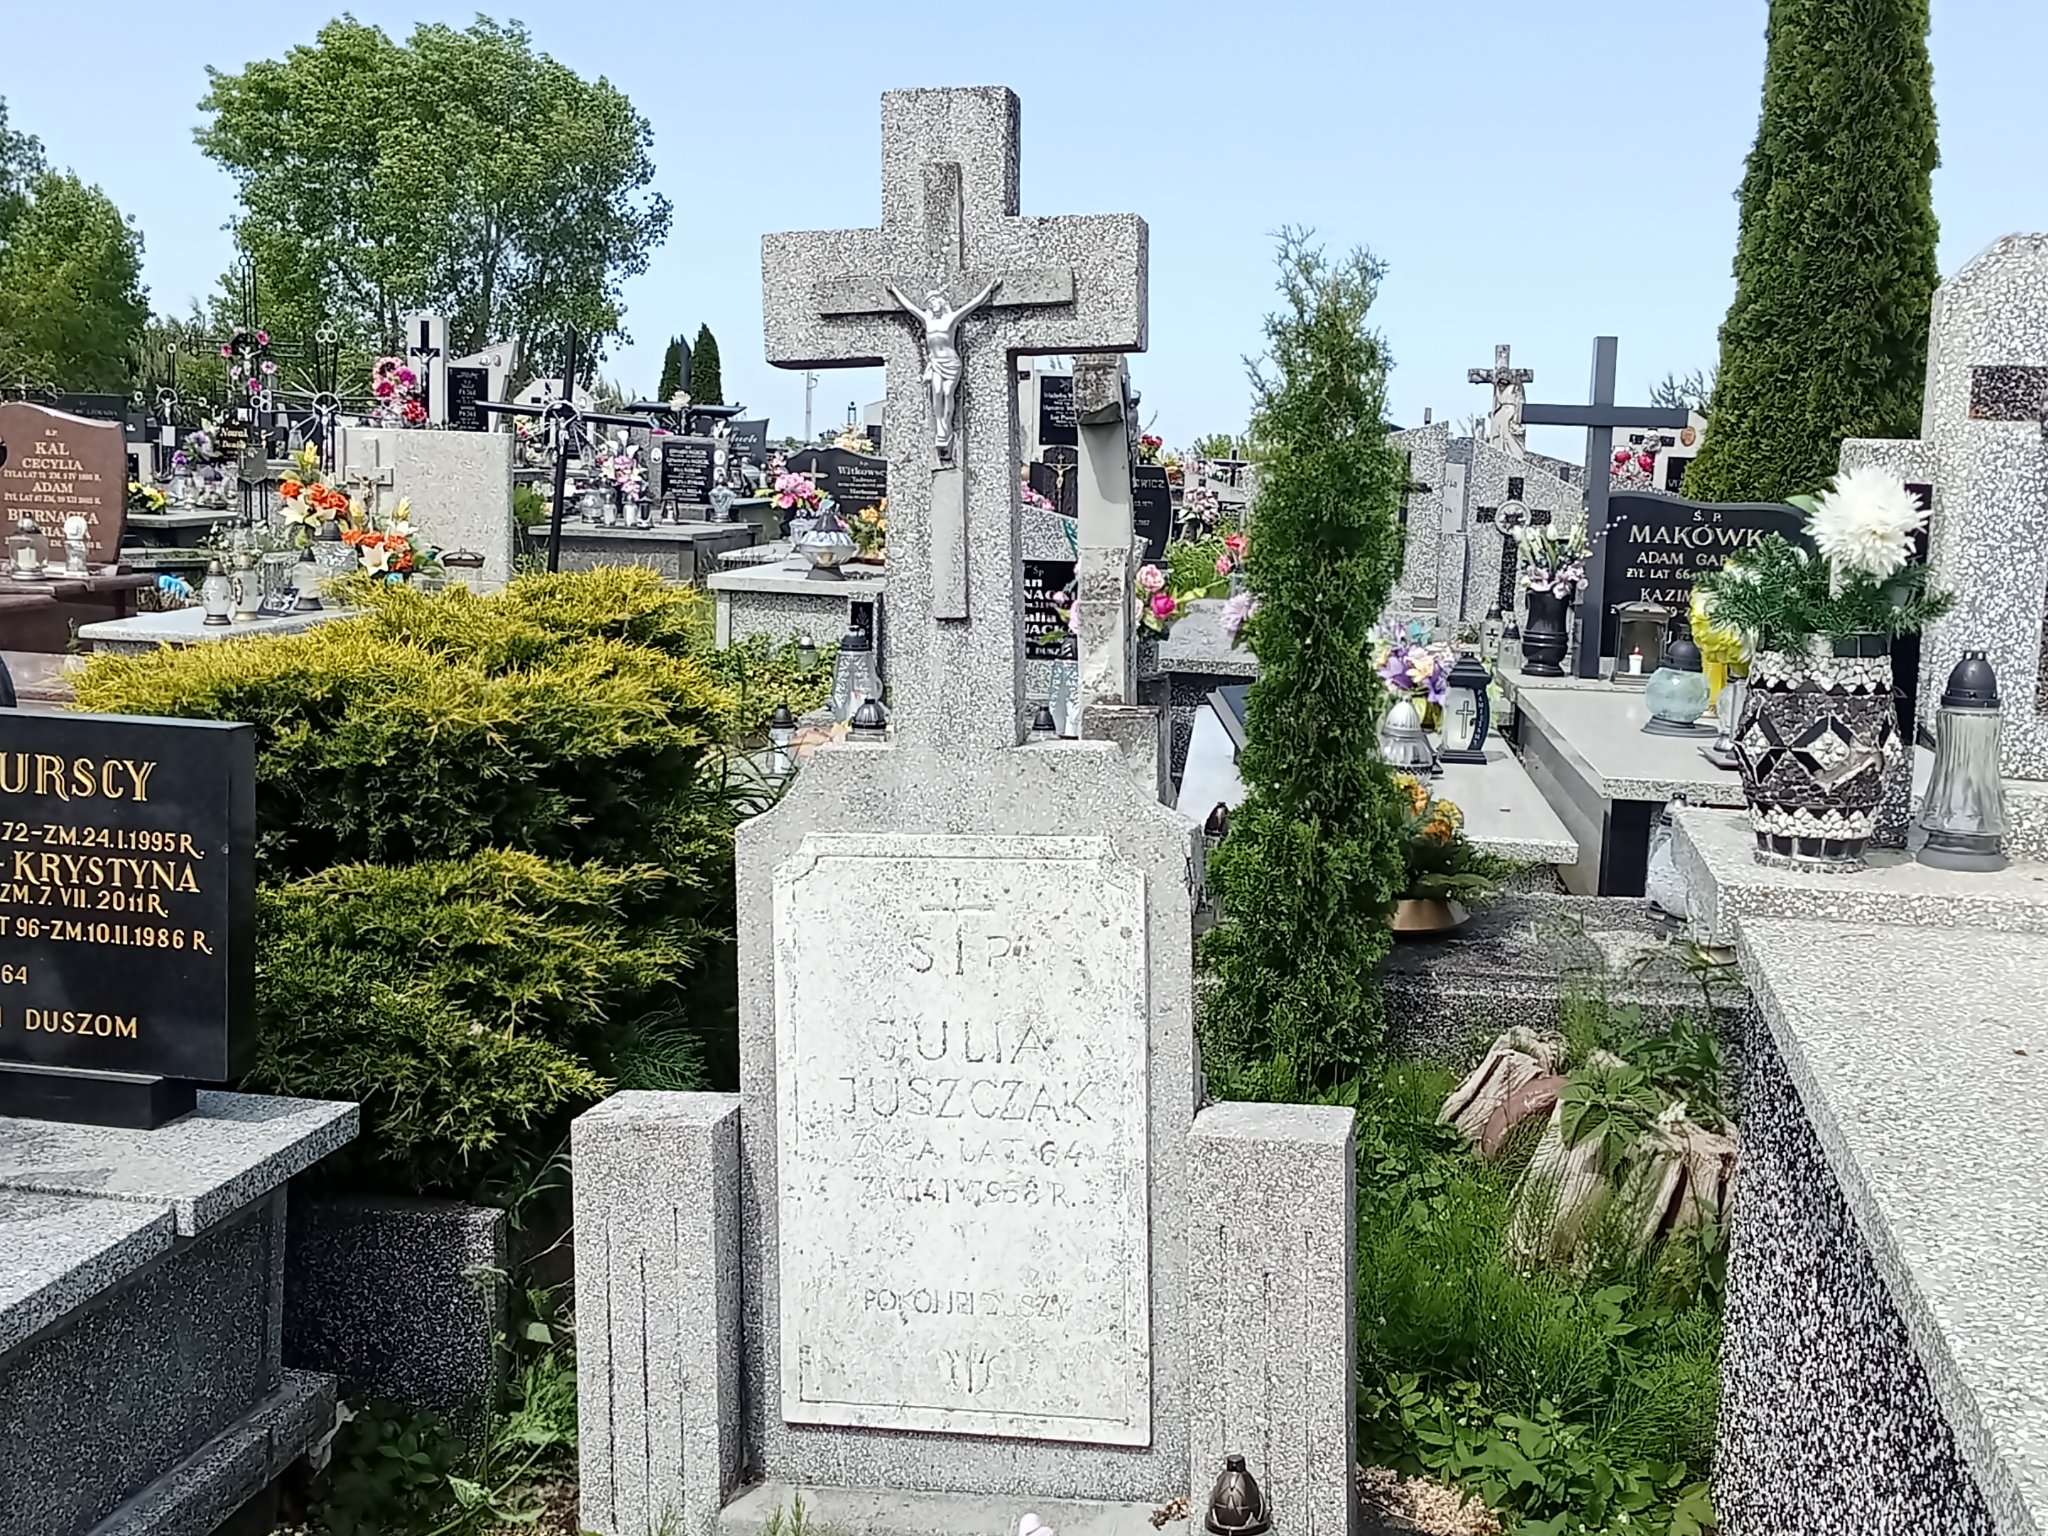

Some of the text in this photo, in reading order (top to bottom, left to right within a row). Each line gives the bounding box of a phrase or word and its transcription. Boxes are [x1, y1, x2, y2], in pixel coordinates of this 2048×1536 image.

[35, 441, 70, 456] KAL
[22, 457, 83, 471] CECYLIA
[32, 481, 73, 494] ADAM
[1628, 524, 1766, 550] MAKÓWK
[1636, 551, 1684, 566] ADAM
[1650, 569, 1670, 580] LAT
[13, 851, 201, 893] KRYSTYNA
[0, 883, 34, 905] ZM.
[38, 886, 53, 906] 7.
[60, 887, 92, 909] VII.
[193, 930, 213, 955] R.
[25, 1008, 138, 1039] DUSZOM
[839, 1077, 1096, 1122] JUSZCZAK
